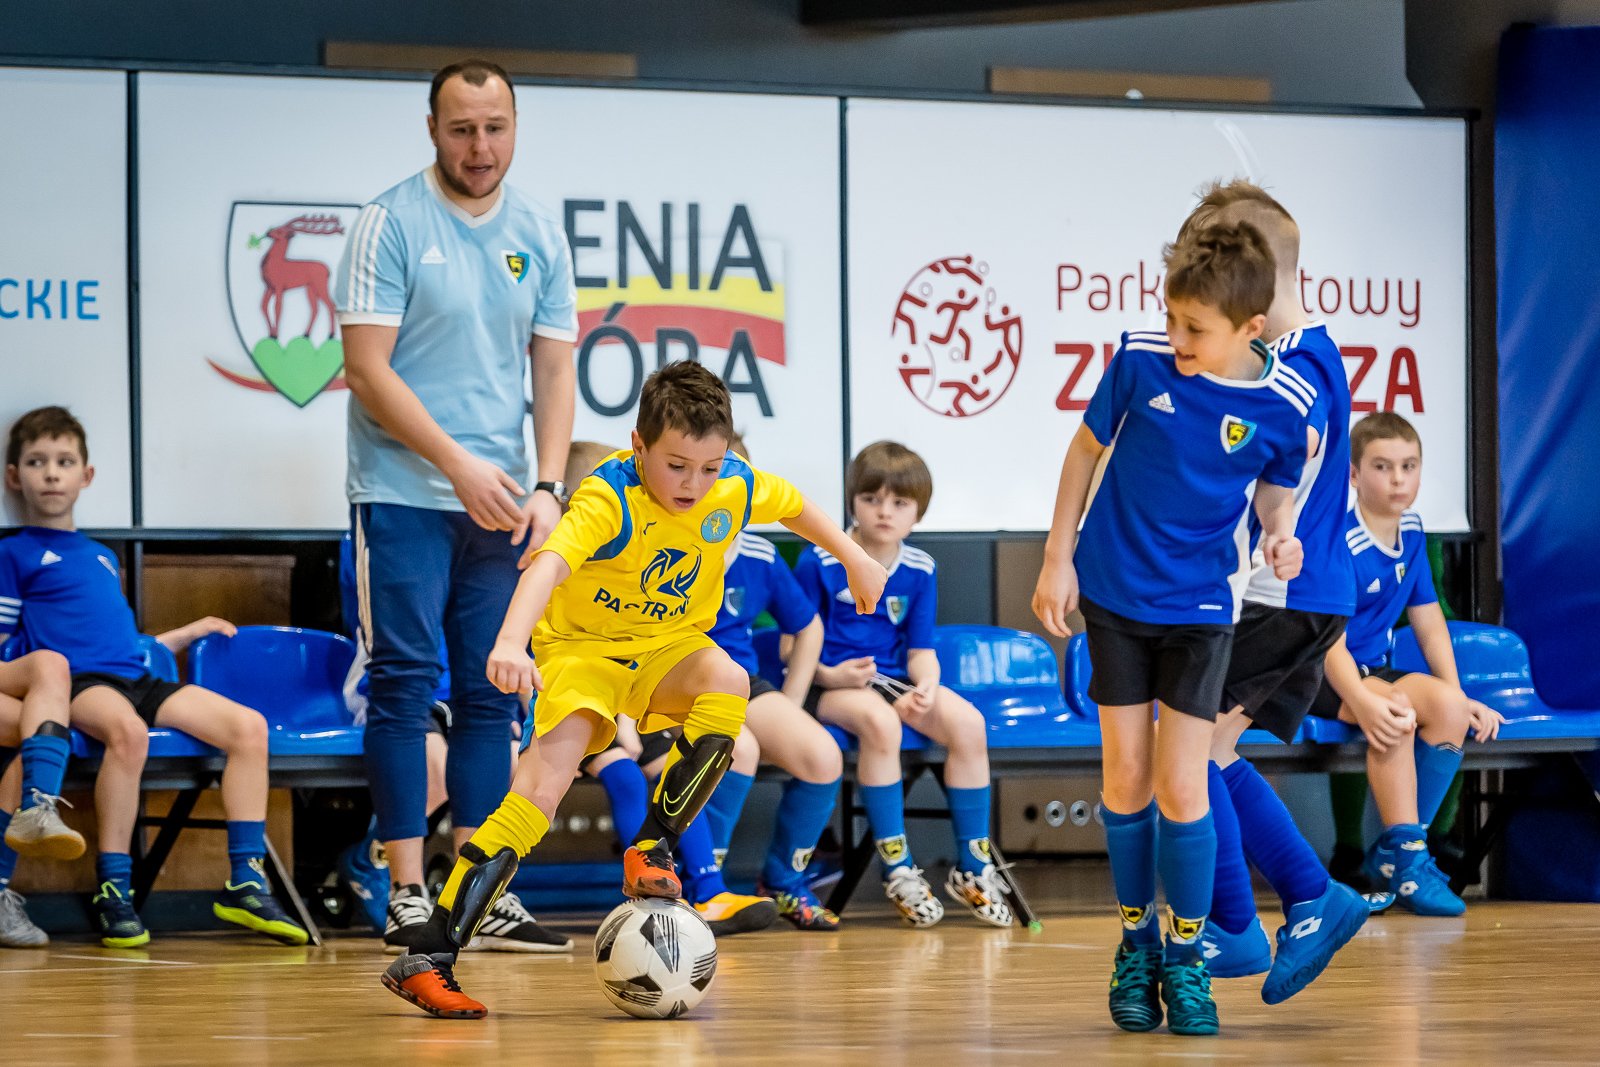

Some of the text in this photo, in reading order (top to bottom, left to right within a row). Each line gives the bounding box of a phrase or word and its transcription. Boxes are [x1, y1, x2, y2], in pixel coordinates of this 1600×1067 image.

[563, 199, 774, 292] ENIA
[0, 278, 100, 320] CKIE
[1057, 260, 1163, 311] Park
[577, 303, 775, 417] ÓA
[593, 587, 689, 621] PATRN
